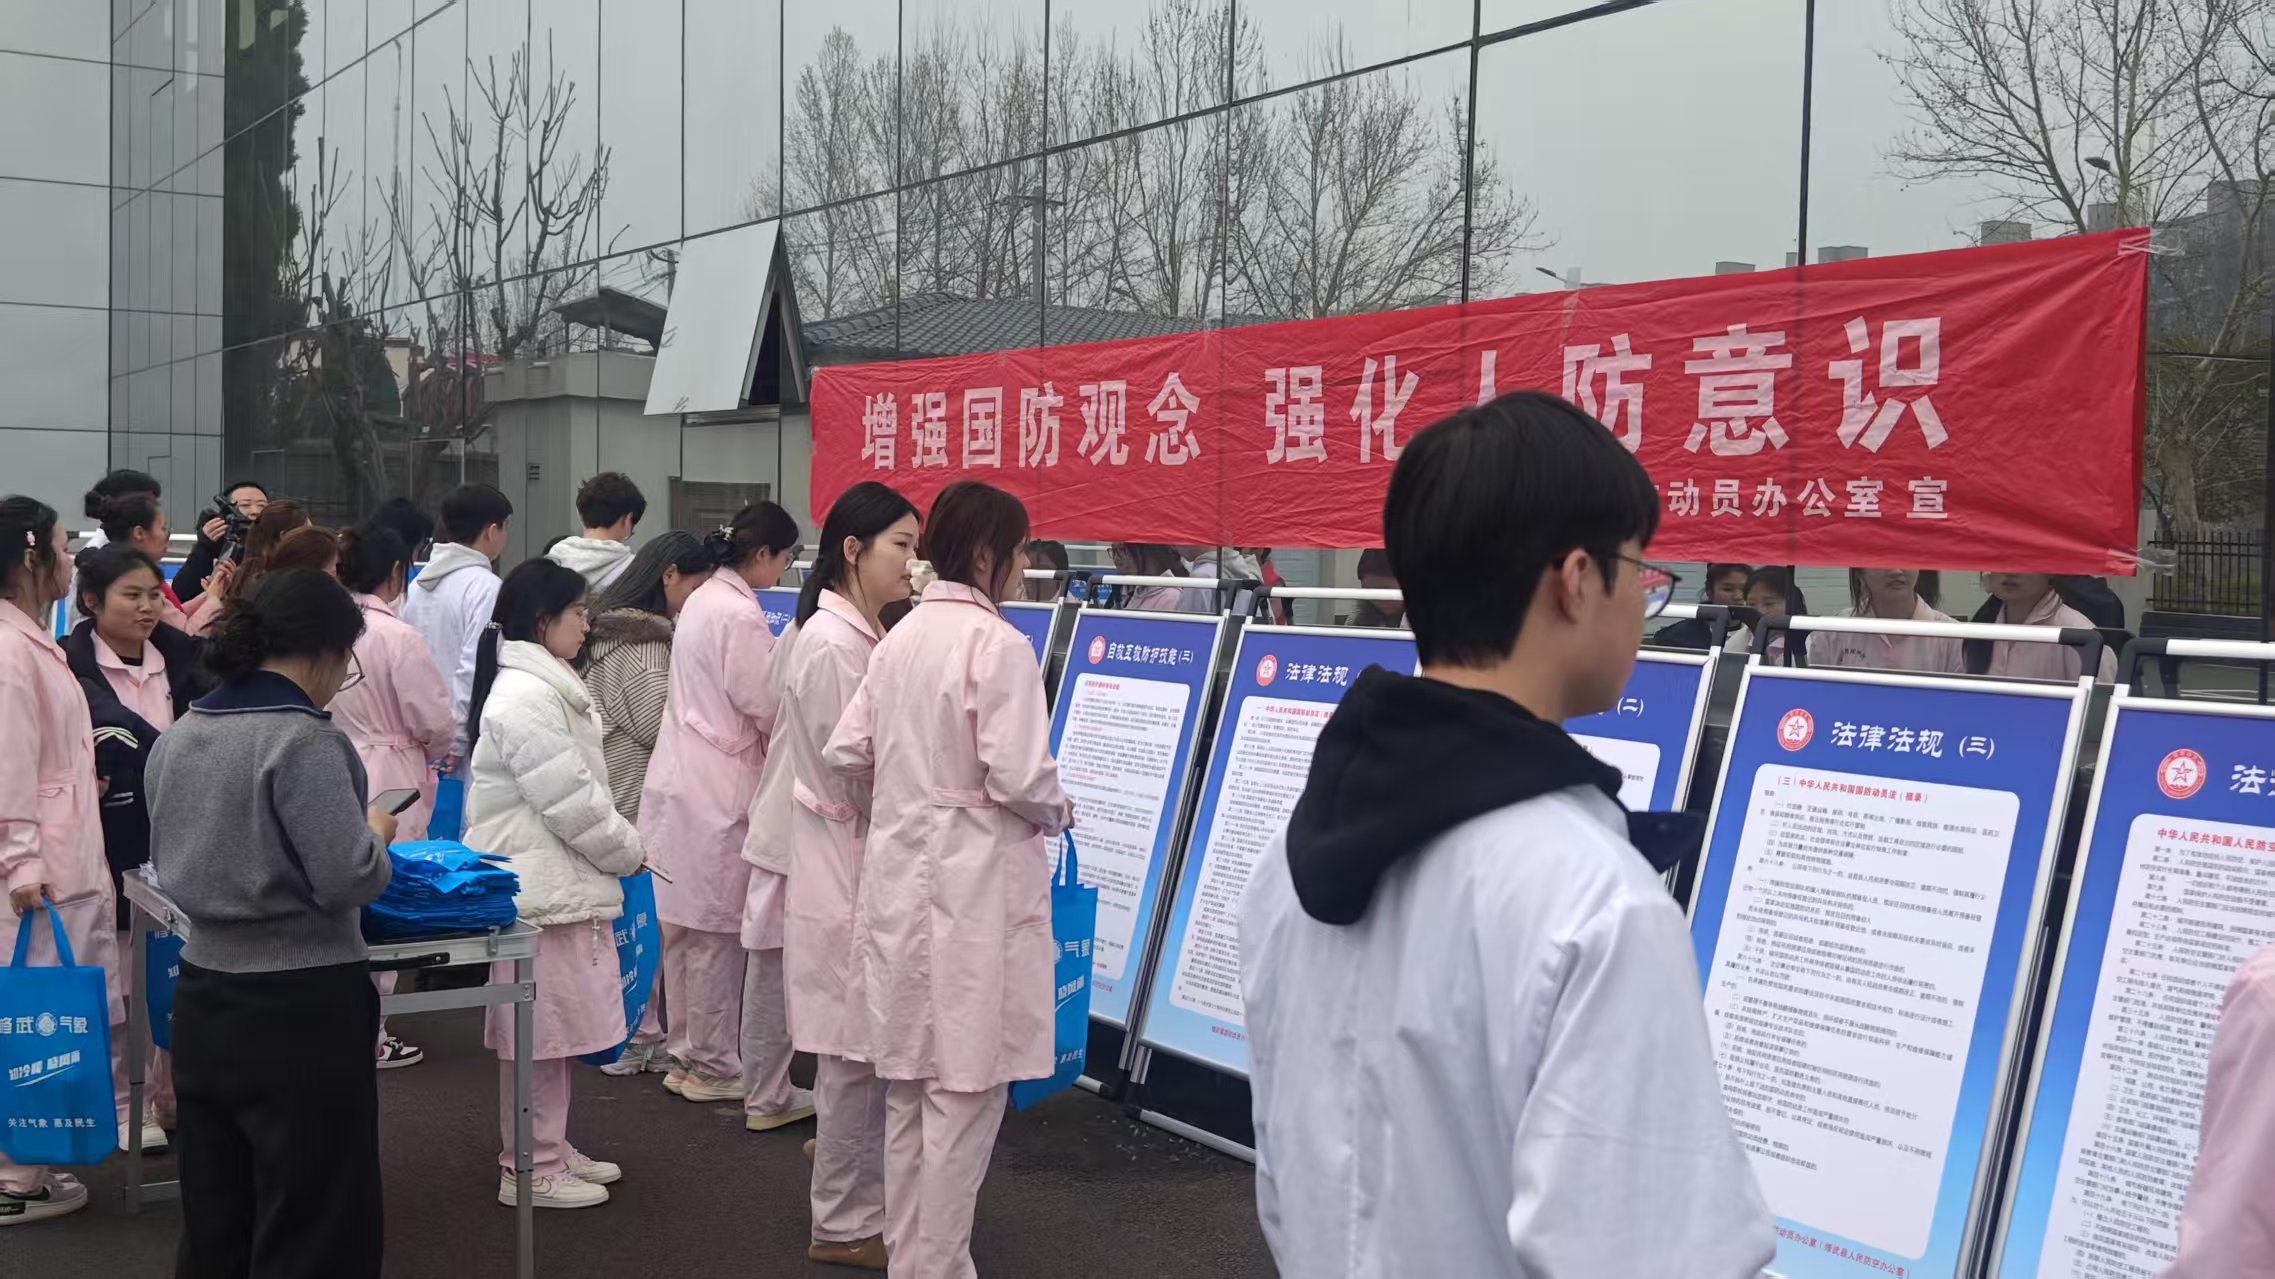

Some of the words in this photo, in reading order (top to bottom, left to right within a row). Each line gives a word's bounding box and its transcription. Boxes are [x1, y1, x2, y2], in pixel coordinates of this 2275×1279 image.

[861, 372, 1201, 470] 增强国防观念
[1655, 476, 1884, 519] 动员办公室
[1906, 476, 1949, 519] 宣
[59, 1016, 88, 1034] 气象
